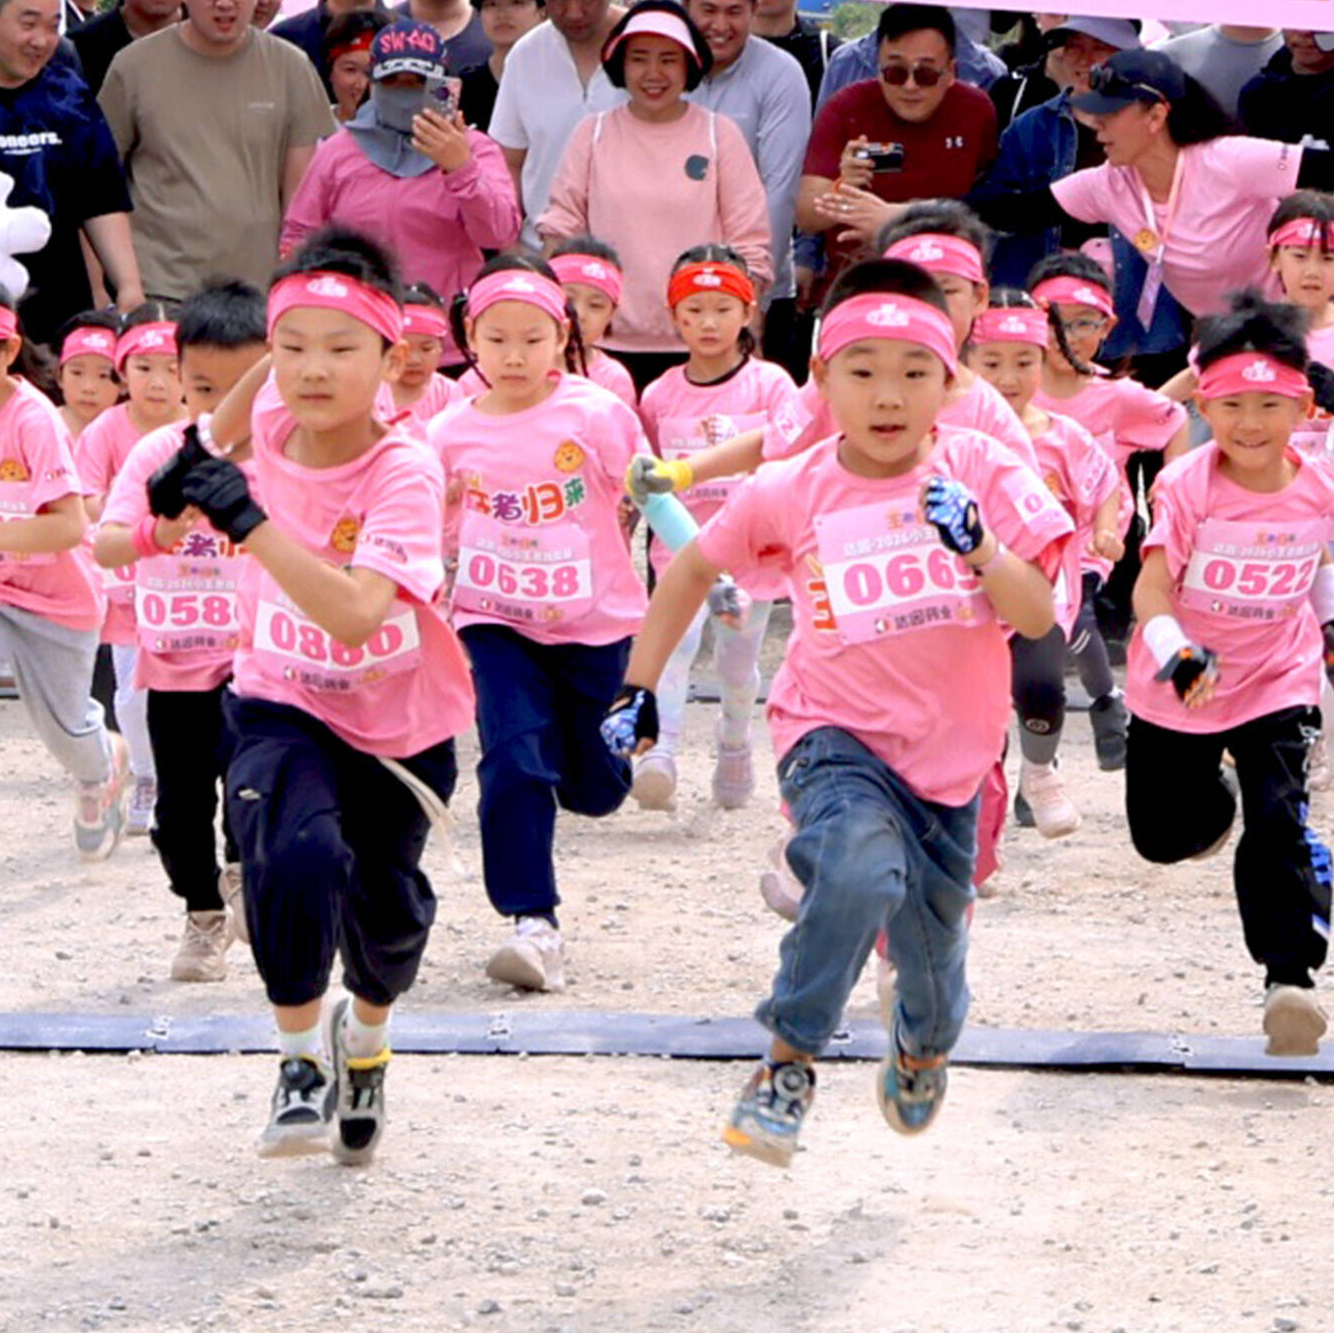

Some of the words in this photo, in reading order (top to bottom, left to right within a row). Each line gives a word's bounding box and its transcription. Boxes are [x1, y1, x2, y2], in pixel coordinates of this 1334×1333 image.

[469, 555, 579, 598] 0638
[1203, 559, 1315, 595] 0522
[143, 594, 238, 625] 058
